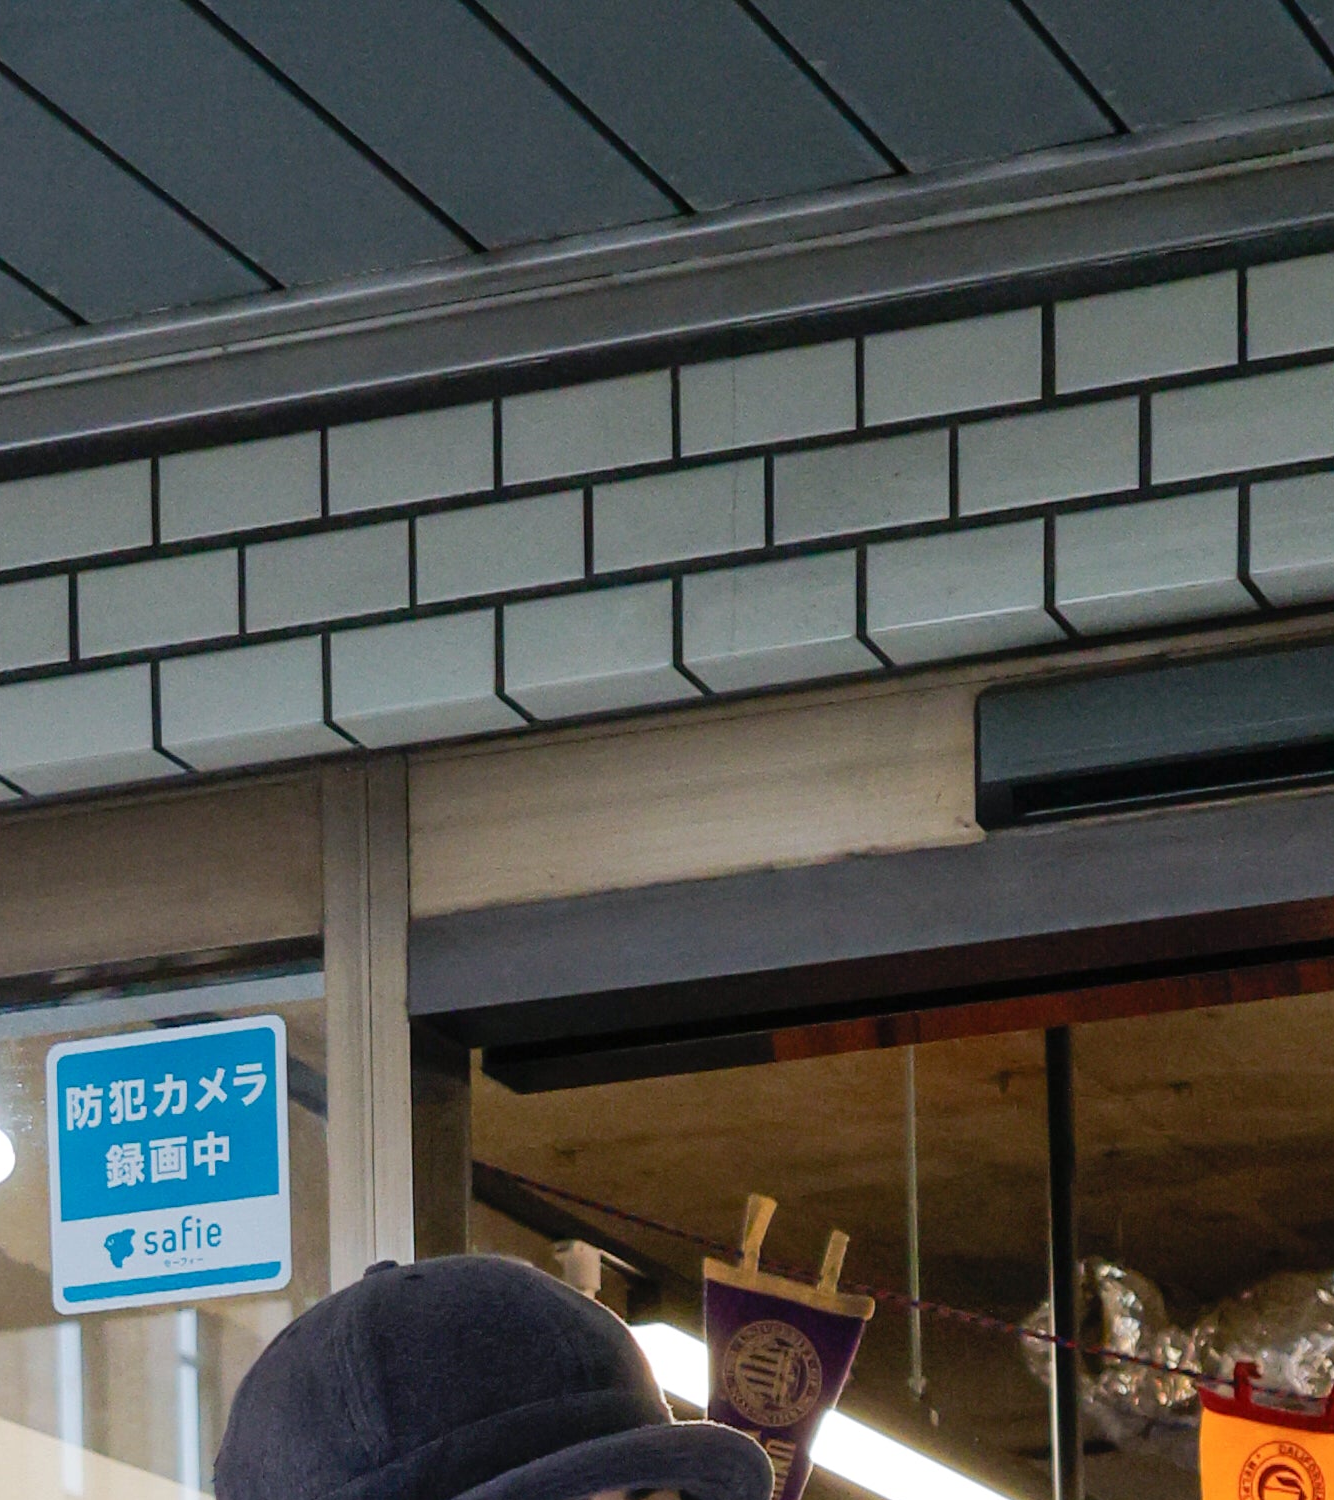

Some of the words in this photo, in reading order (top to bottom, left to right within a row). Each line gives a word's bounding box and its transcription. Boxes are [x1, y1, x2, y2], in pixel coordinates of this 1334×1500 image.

[66, 1062, 268, 1131] 防犯カメラ
[105, 1130, 231, 1189] 録画中
[143, 1215, 223, 1256] safie
